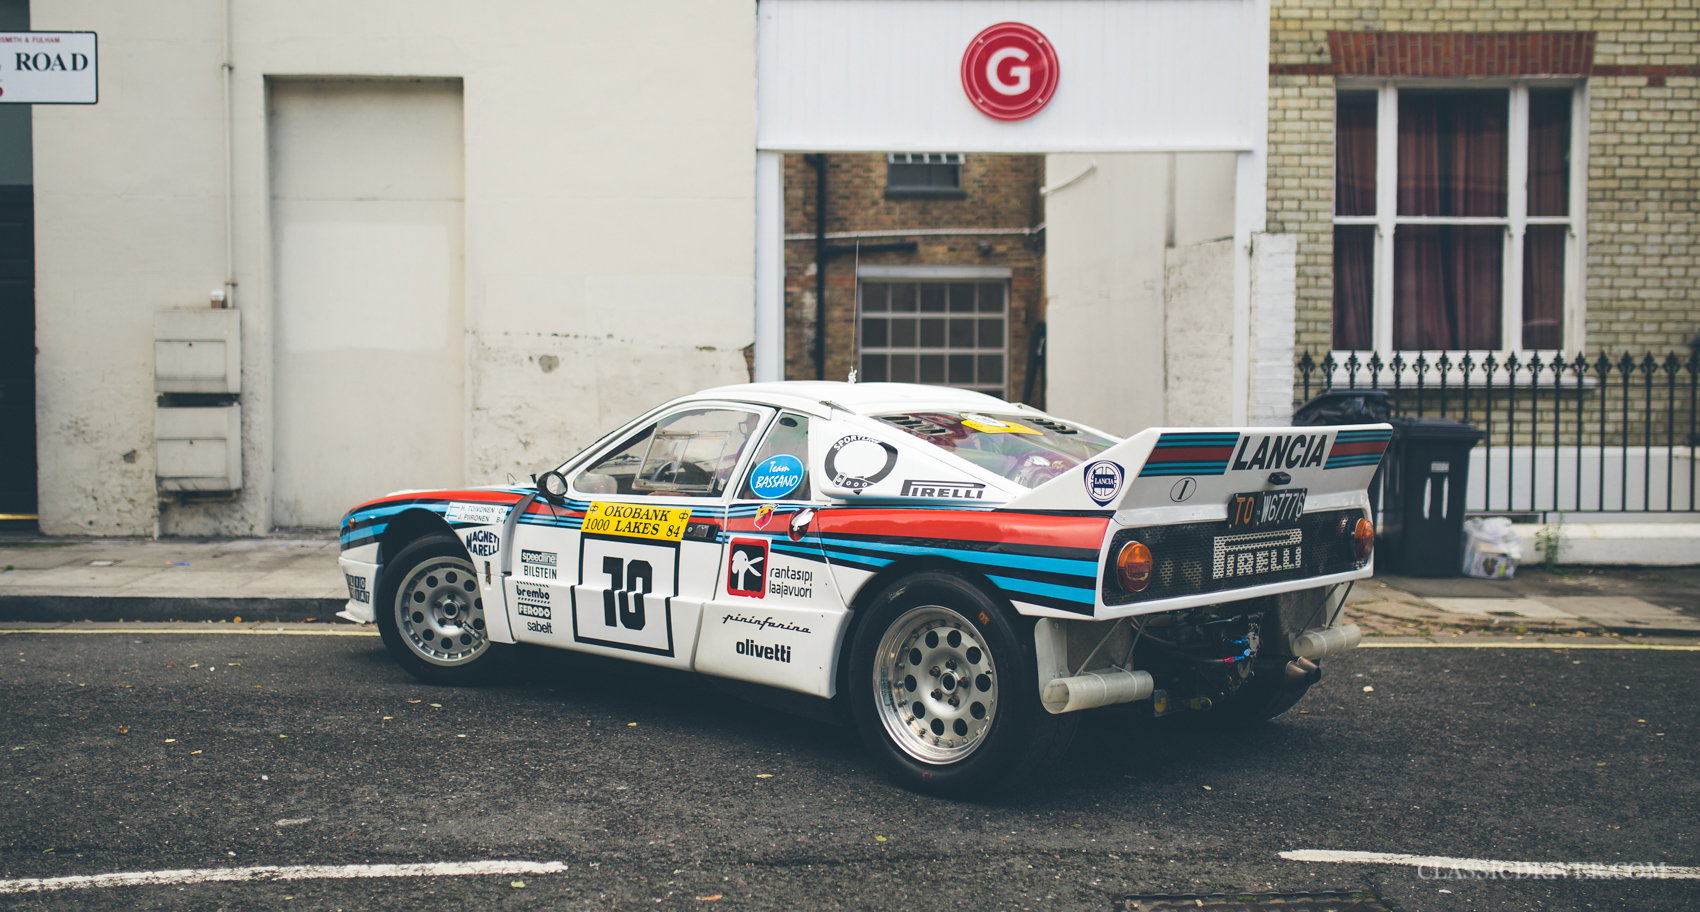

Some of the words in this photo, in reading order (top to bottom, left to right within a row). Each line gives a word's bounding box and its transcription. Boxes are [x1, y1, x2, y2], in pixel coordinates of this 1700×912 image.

[15, 52, 88, 71] ROAD
[986, 46, 1031, 96] G
[1231, 434, 1328, 471] LANCIA
[768, 461, 790, 473] Team
[754, 474, 799, 490] BASSANO
[900, 480, 987, 499] PIRELLI
[1094, 477, 1114, 485] LANCIA
[1177, 479, 1191, 501] I
[604, 505, 671, 522] OKOBANK
[1235, 496, 1255, 526] TO
[1261, 492, 1305, 523] W67776
[585, 517, 610, 532] 1000
[614, 520, 660, 536] LAKES
[666, 525, 681, 538] 84
[466, 530, 499, 546] MAGNETI
[466, 541, 499, 556] MARELLI
[1213, 528, 1303, 579] PIRELLI
[522, 551, 557, 564] speedline
[524, 565, 557, 580] BILSTEIN
[769, 566, 814, 584] rantasipi
[346, 574, 366, 590] LIO
[769, 581, 813, 599] laajavuori
[351, 589, 370, 604] IAT
[516, 585, 550, 600] brembo
[603, 556, 653, 631] 10
[518, 604, 551, 618] FERODO
[527, 620, 553, 635] sabelt
[722, 613, 811, 634] pininfarina
[736, 638, 791, 663] olivetti
